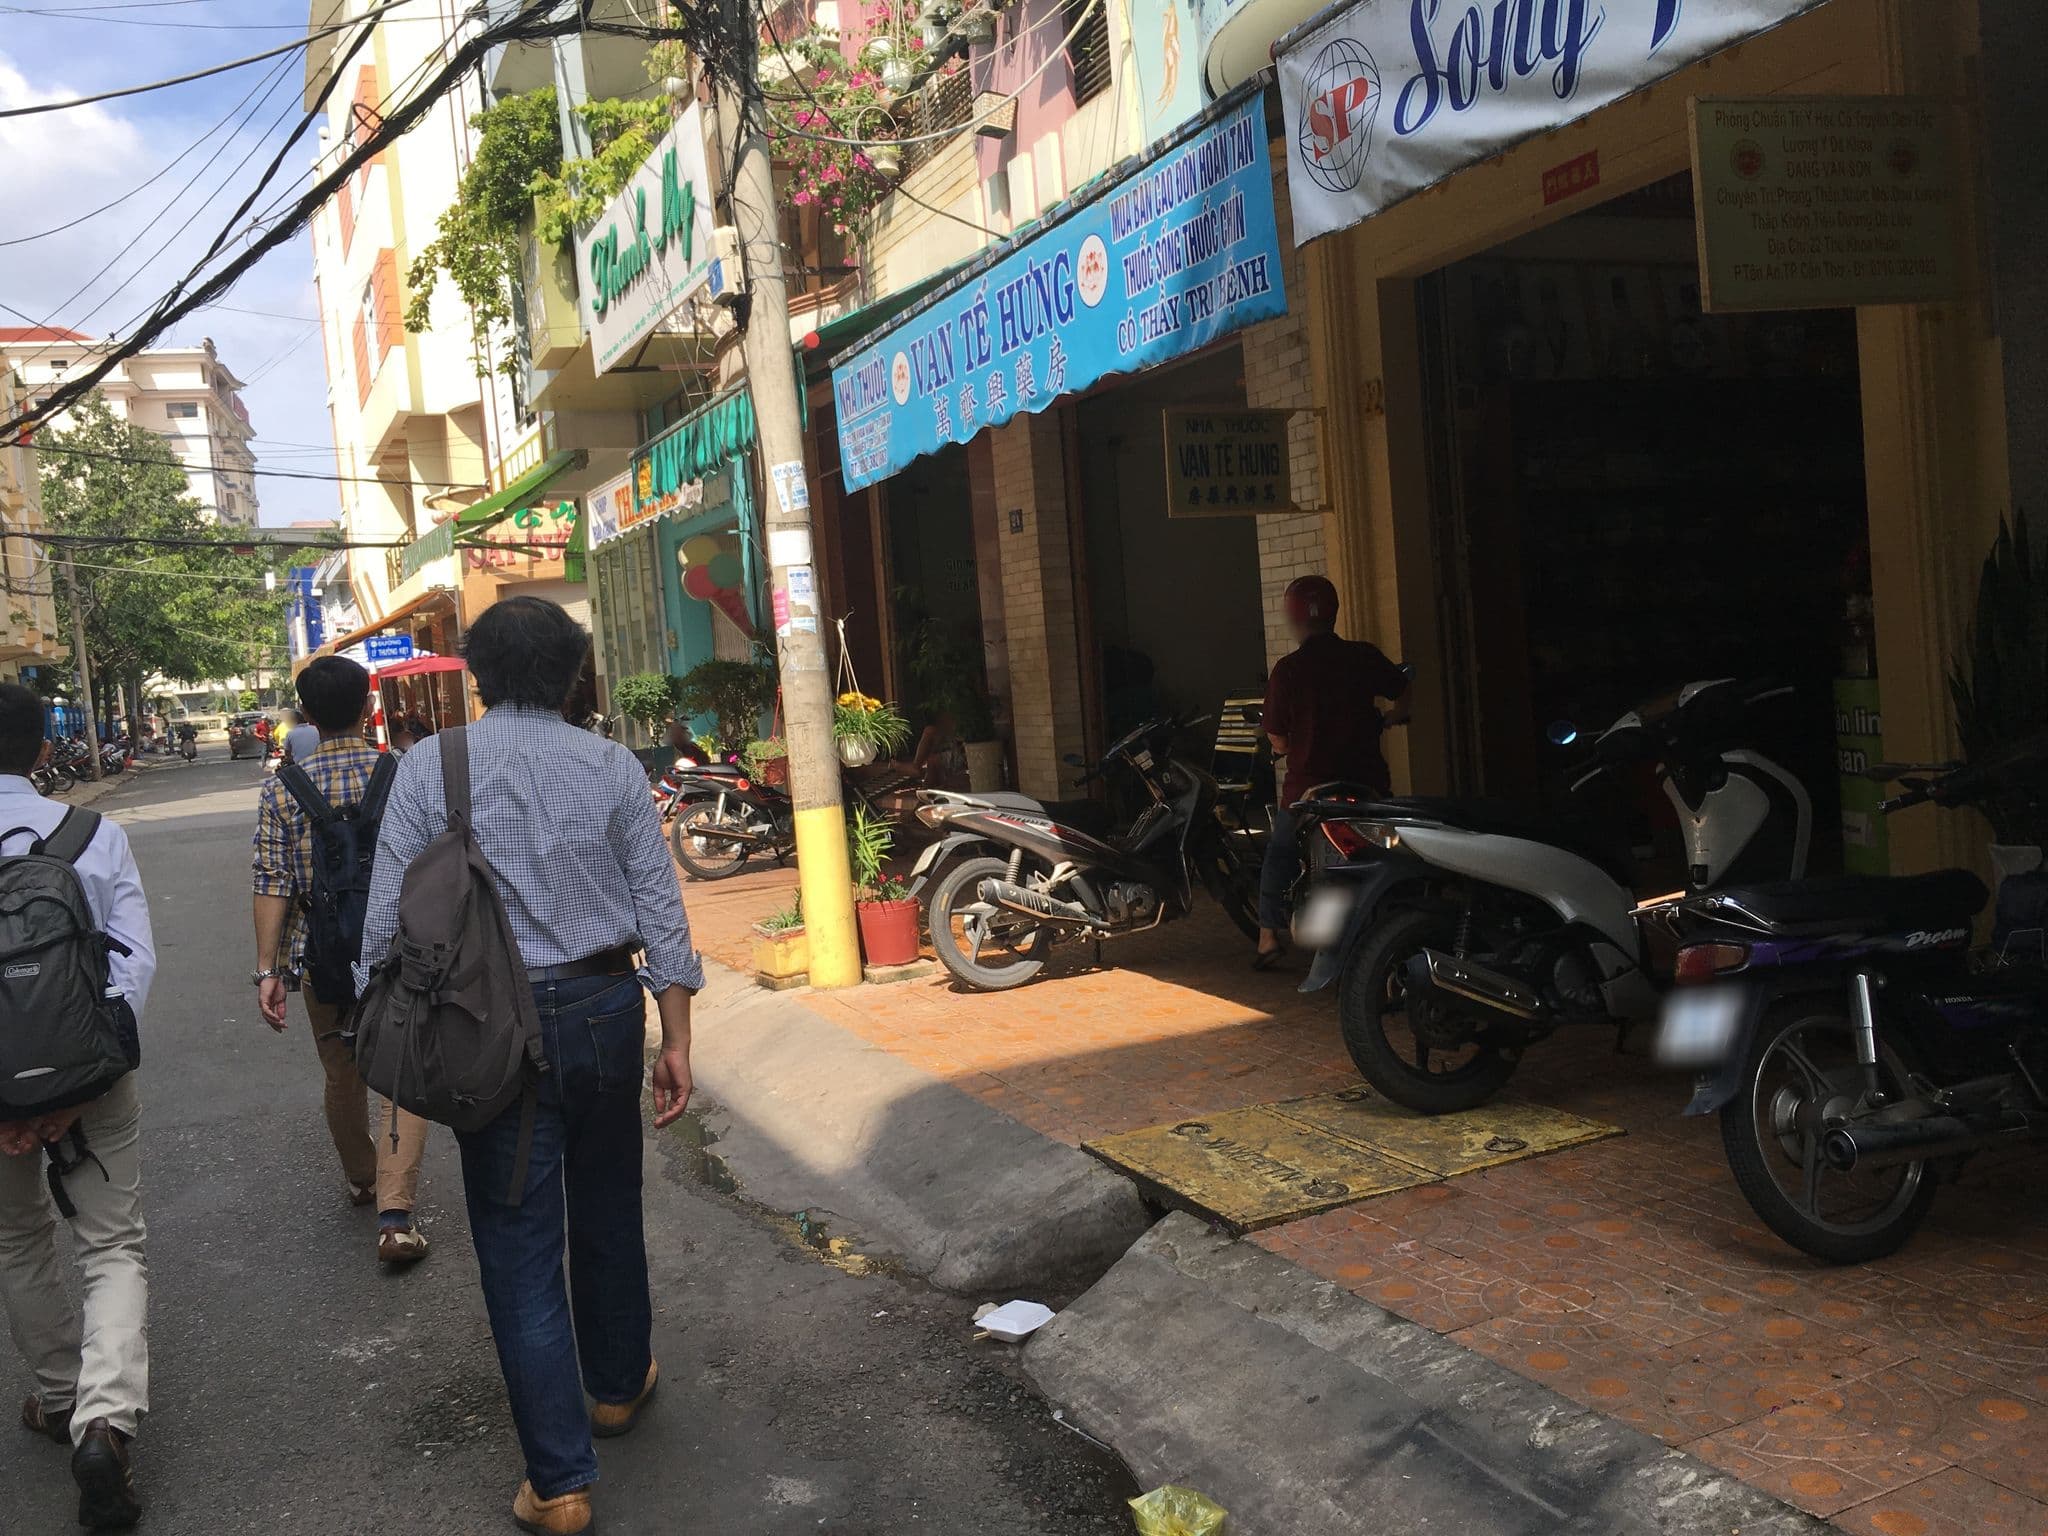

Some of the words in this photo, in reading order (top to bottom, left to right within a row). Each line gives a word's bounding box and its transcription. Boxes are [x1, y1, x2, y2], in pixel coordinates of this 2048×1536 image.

[1309, 76, 1369, 163] SP
[1110, 196, 1132, 244] MUA
[1131, 171, 1154, 231] BÁN
[1153, 163, 1175, 219] CAO
[1198, 125, 1230, 192] HOÀN
[910, 319, 955, 399] VẠN
[959, 276, 992, 374] TẾ
[996, 250, 1075, 356] HƯNG
[1117, 306, 1138, 357] CÓ
[1944, 995, 1974, 1005] HONDA
